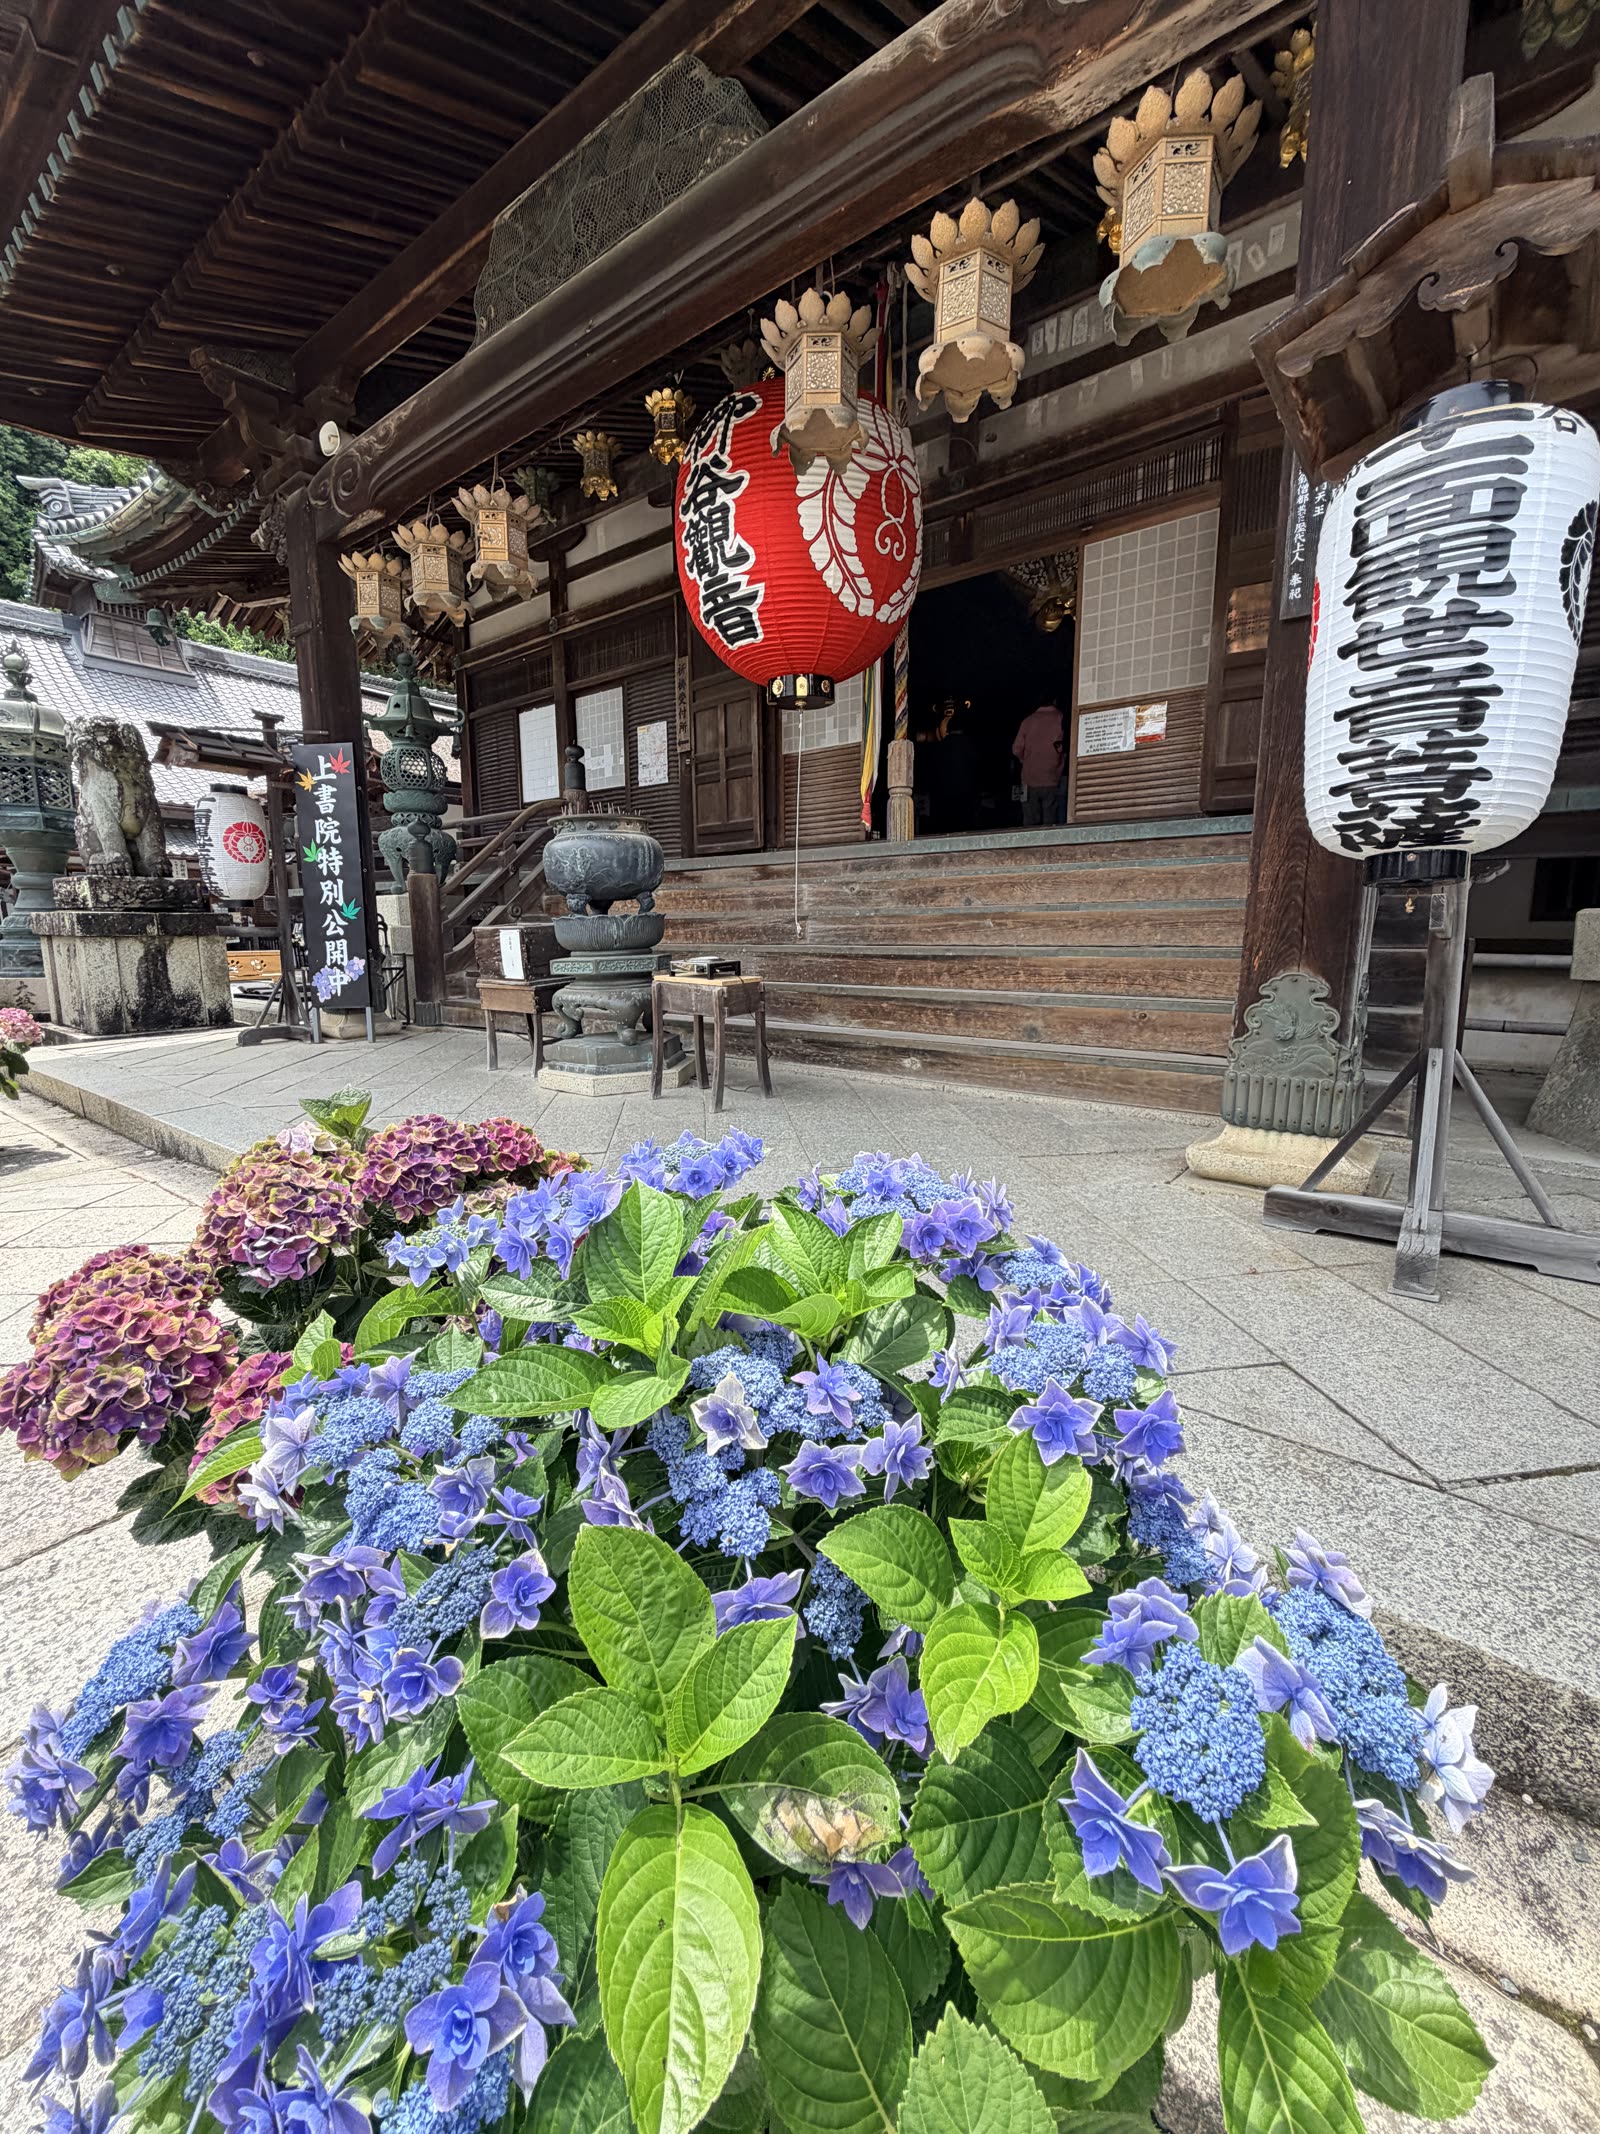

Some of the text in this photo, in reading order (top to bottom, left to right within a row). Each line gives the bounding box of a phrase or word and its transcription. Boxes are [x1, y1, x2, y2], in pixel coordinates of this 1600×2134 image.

[312, 755, 351, 997] 上書院特別公開中
